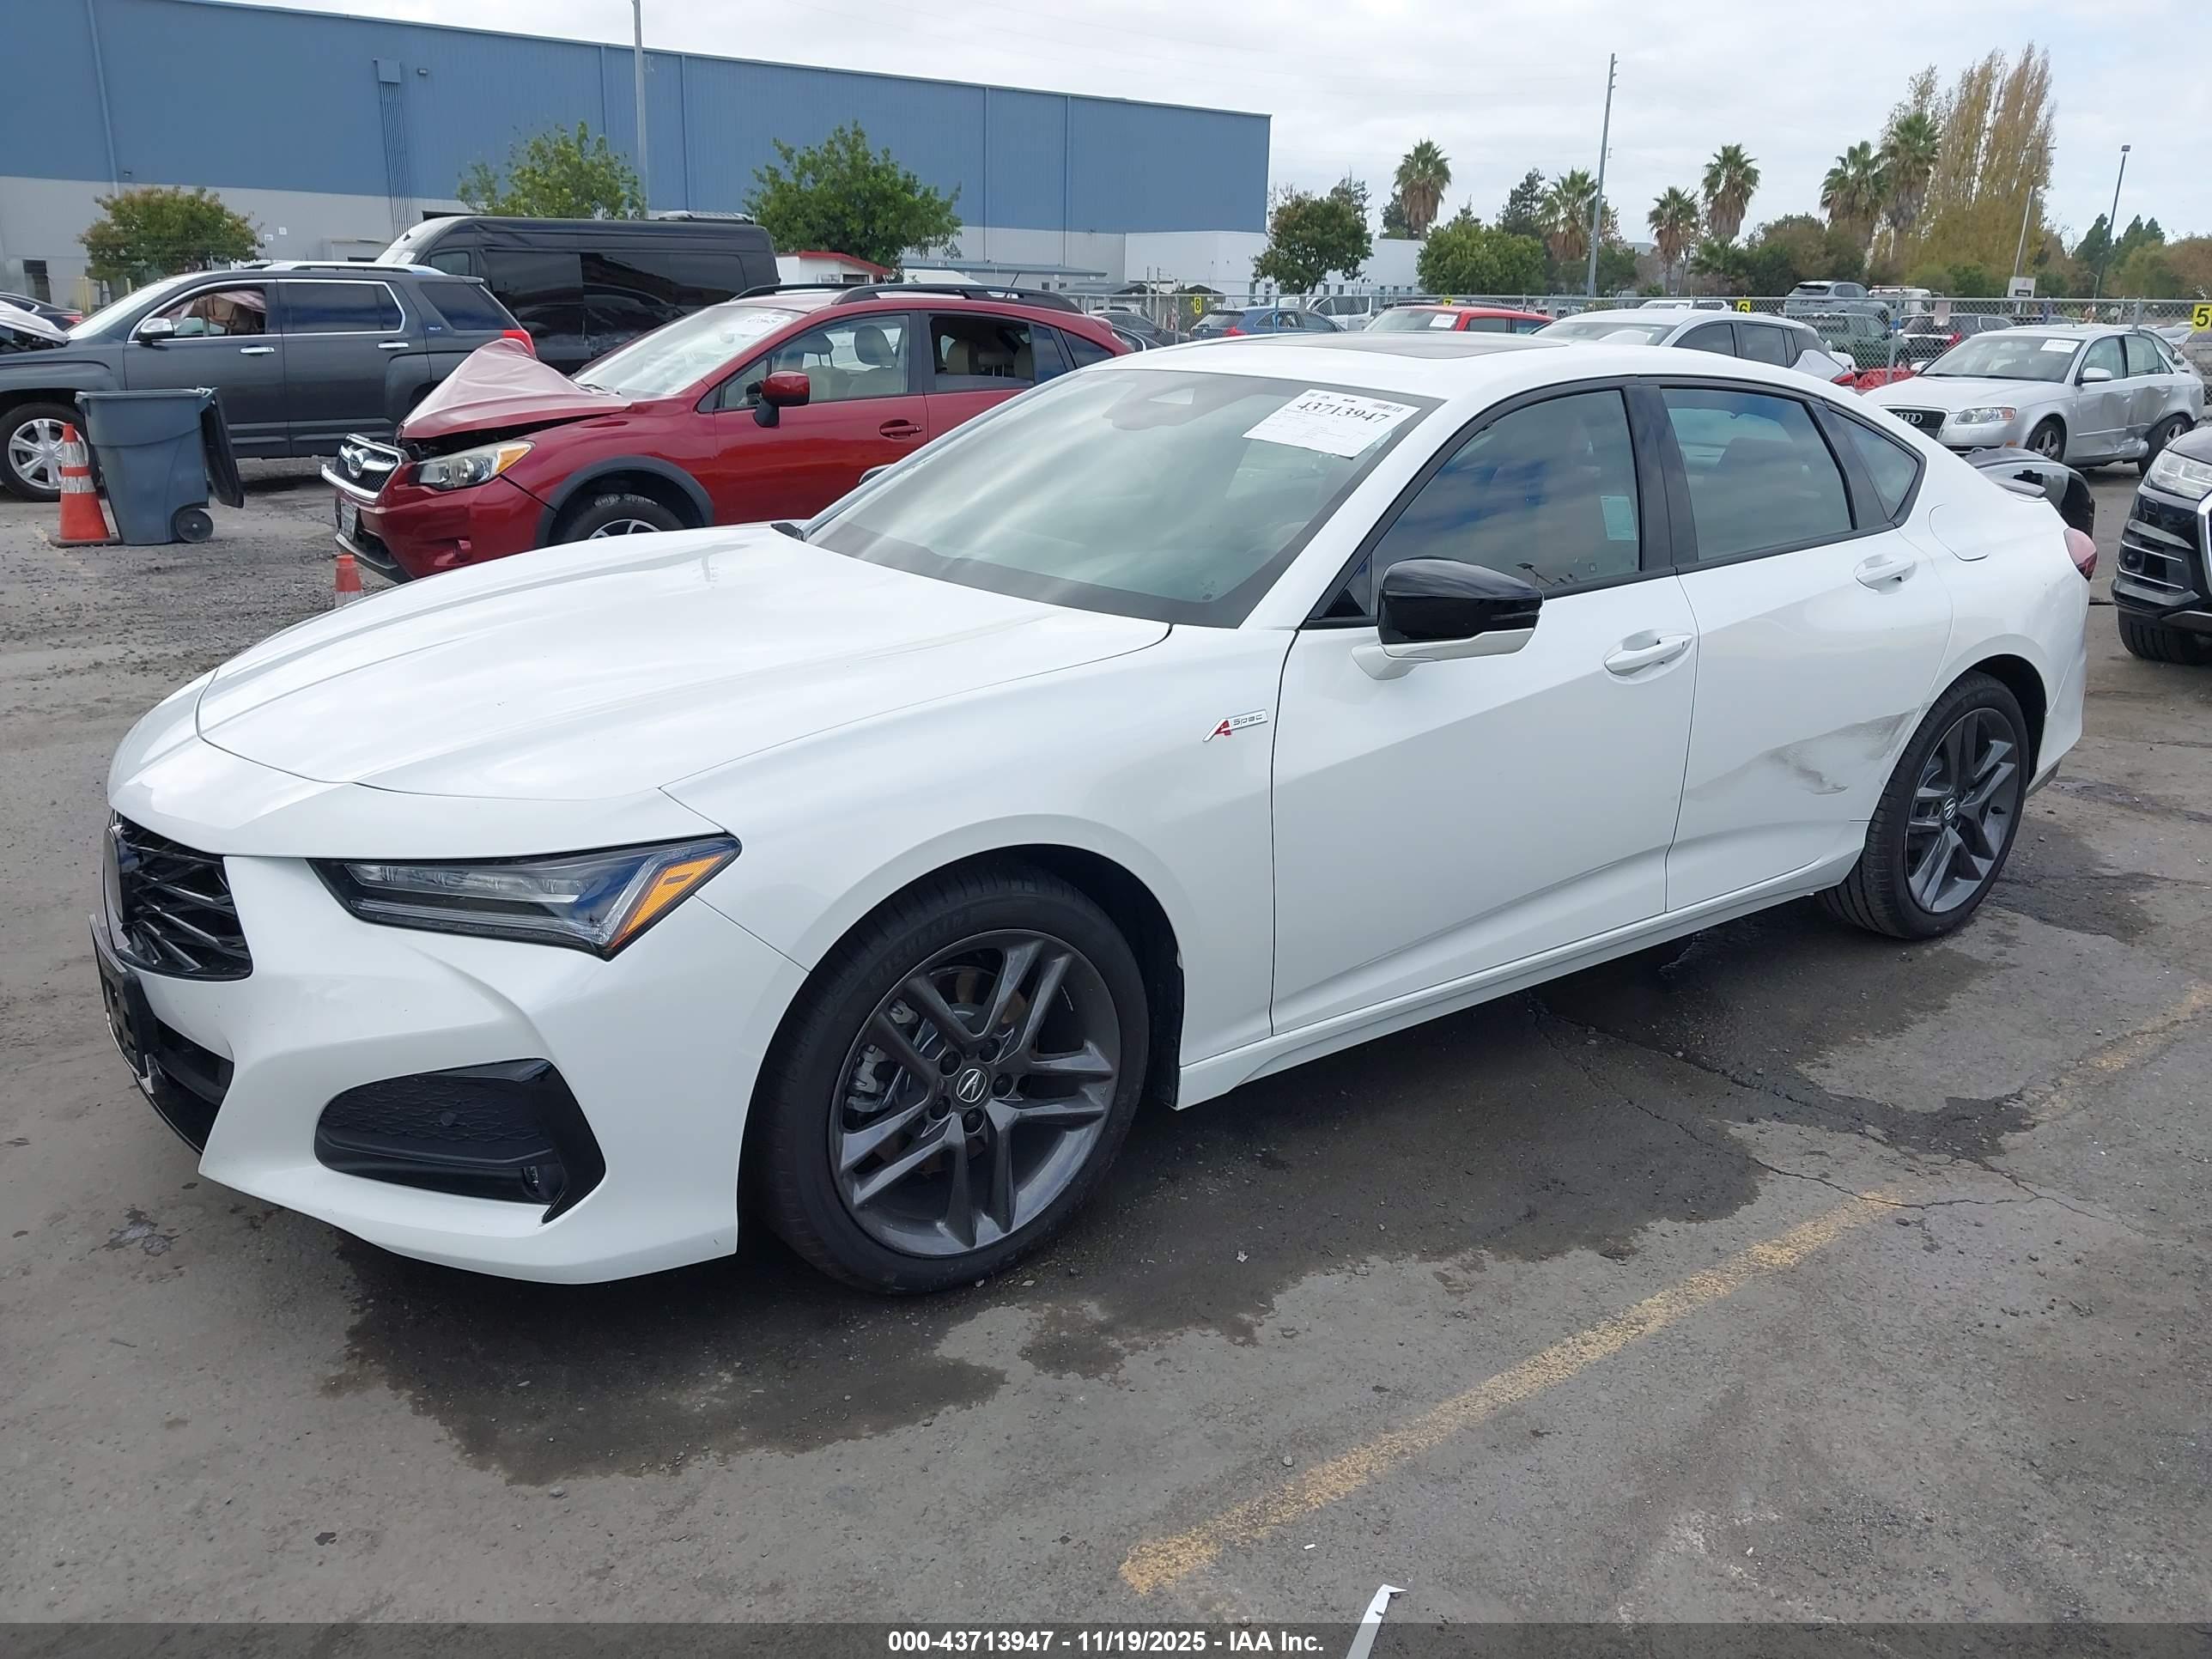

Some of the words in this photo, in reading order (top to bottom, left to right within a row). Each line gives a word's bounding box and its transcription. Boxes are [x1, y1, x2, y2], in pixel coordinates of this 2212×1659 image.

[1195, 298, 1200, 311] 8
[2195, 307, 2210, 327] 5
[1297, 401, 1390, 424] 43713947
